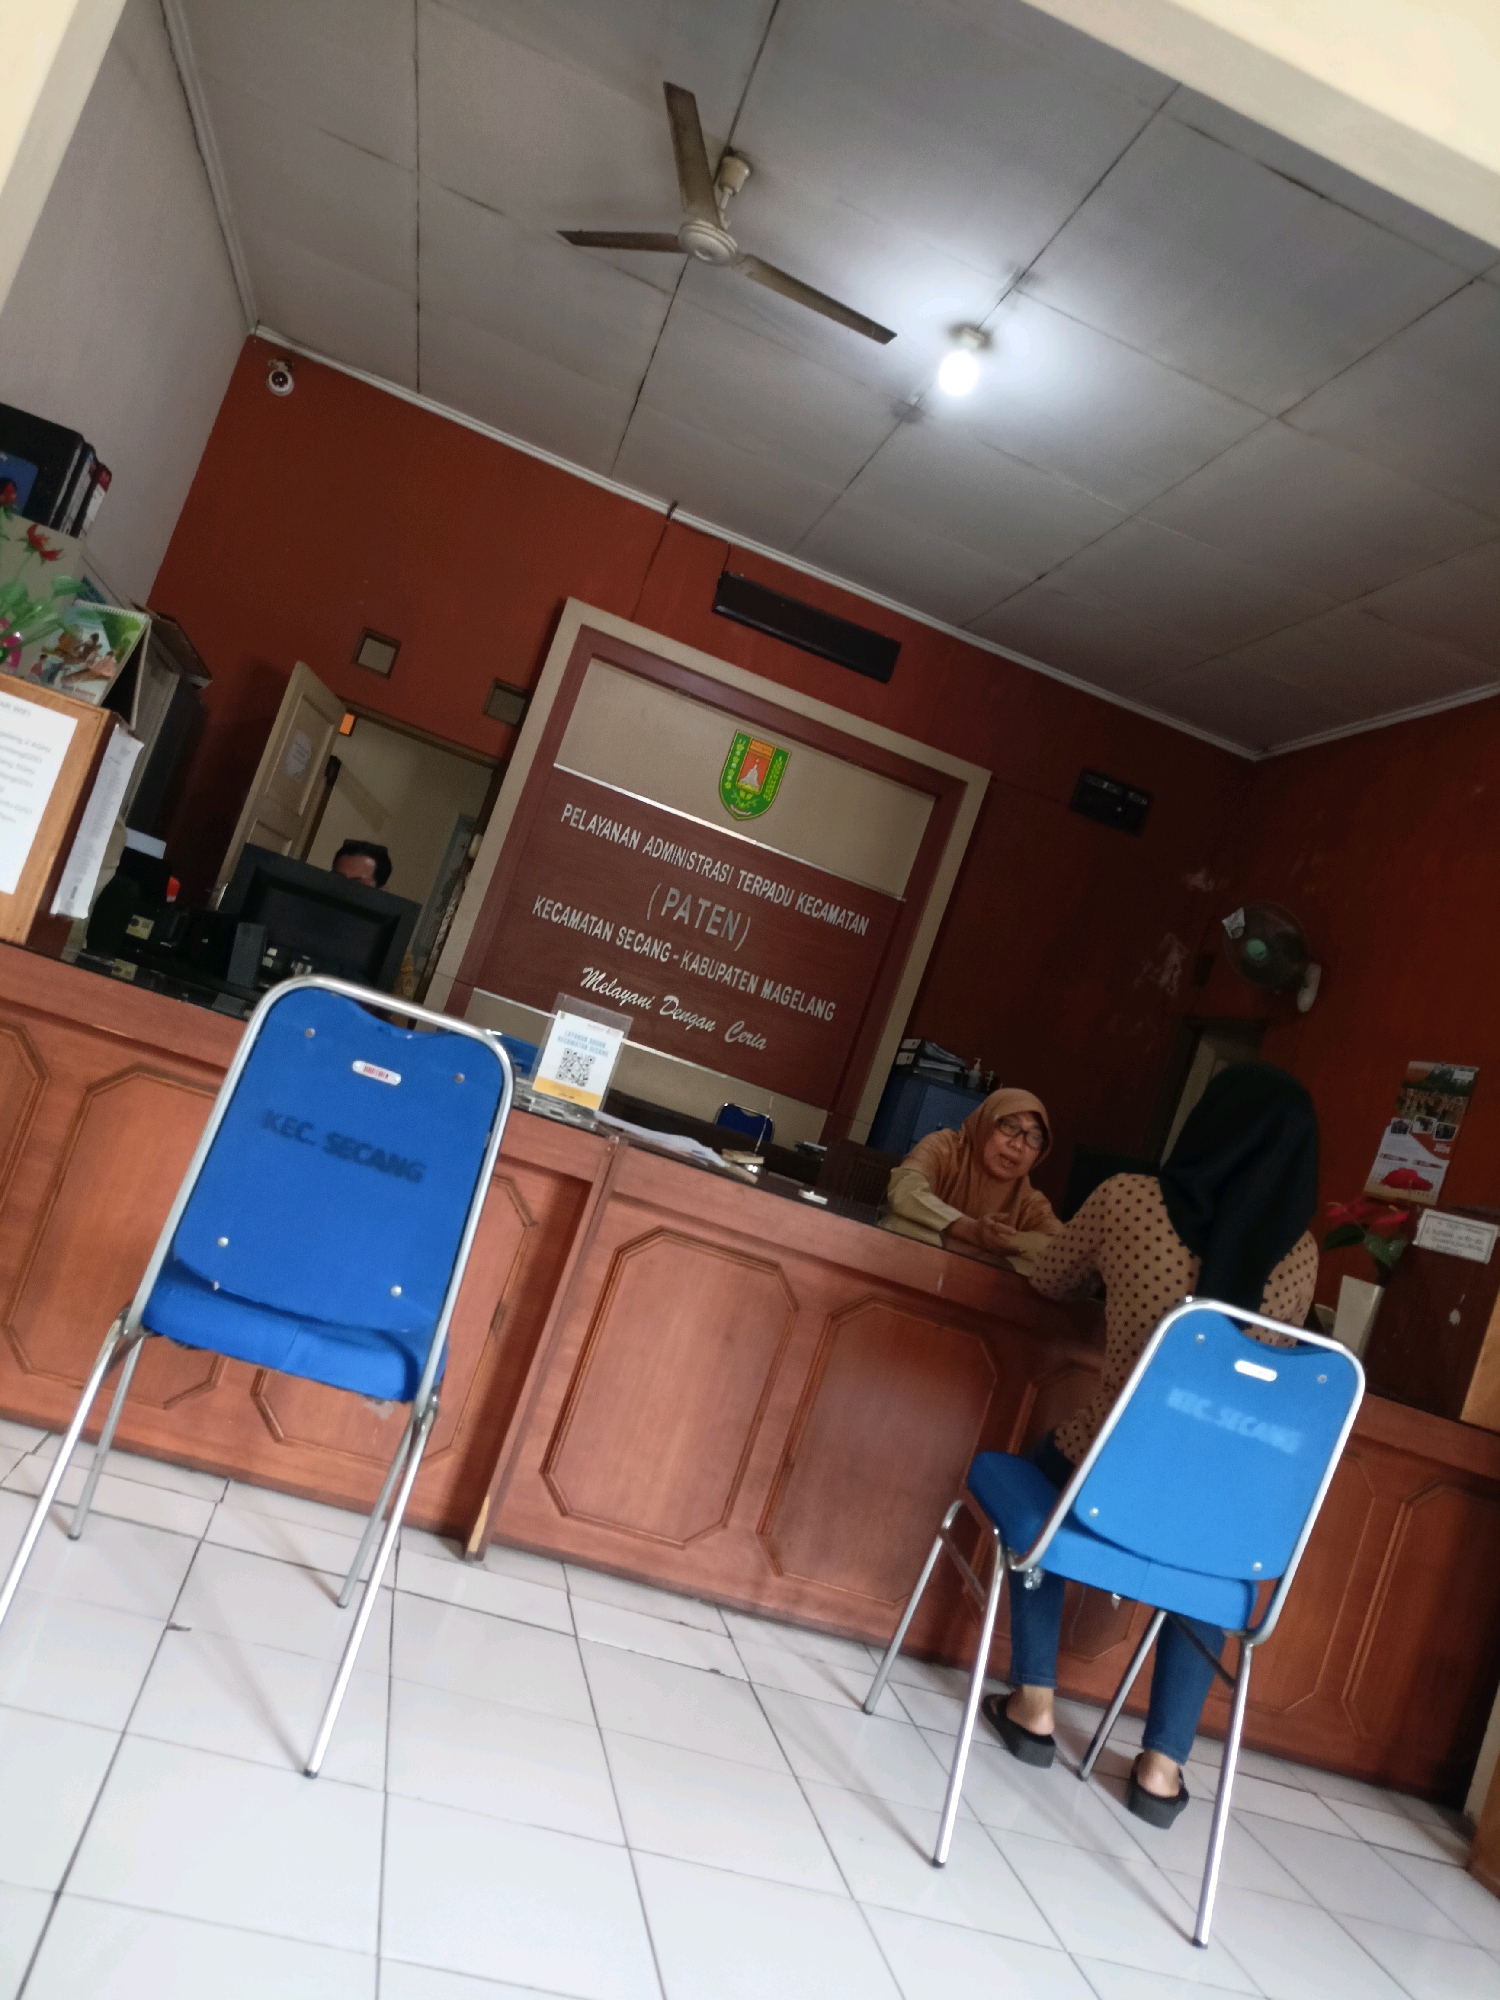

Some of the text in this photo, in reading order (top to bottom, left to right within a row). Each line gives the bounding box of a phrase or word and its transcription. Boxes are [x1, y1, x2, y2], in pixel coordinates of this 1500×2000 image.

[561, 803, 870, 936] PELAYANAN ADMINISTRASI TERPADU KECAMATAN
[532, 895, 615, 942] KECAMATAN
[760, 978, 836, 1021] MAGELANG
[580, 967, 767, 1050] Melayani Dengan Ceria
[323, 1132, 426, 1183] SECANG
